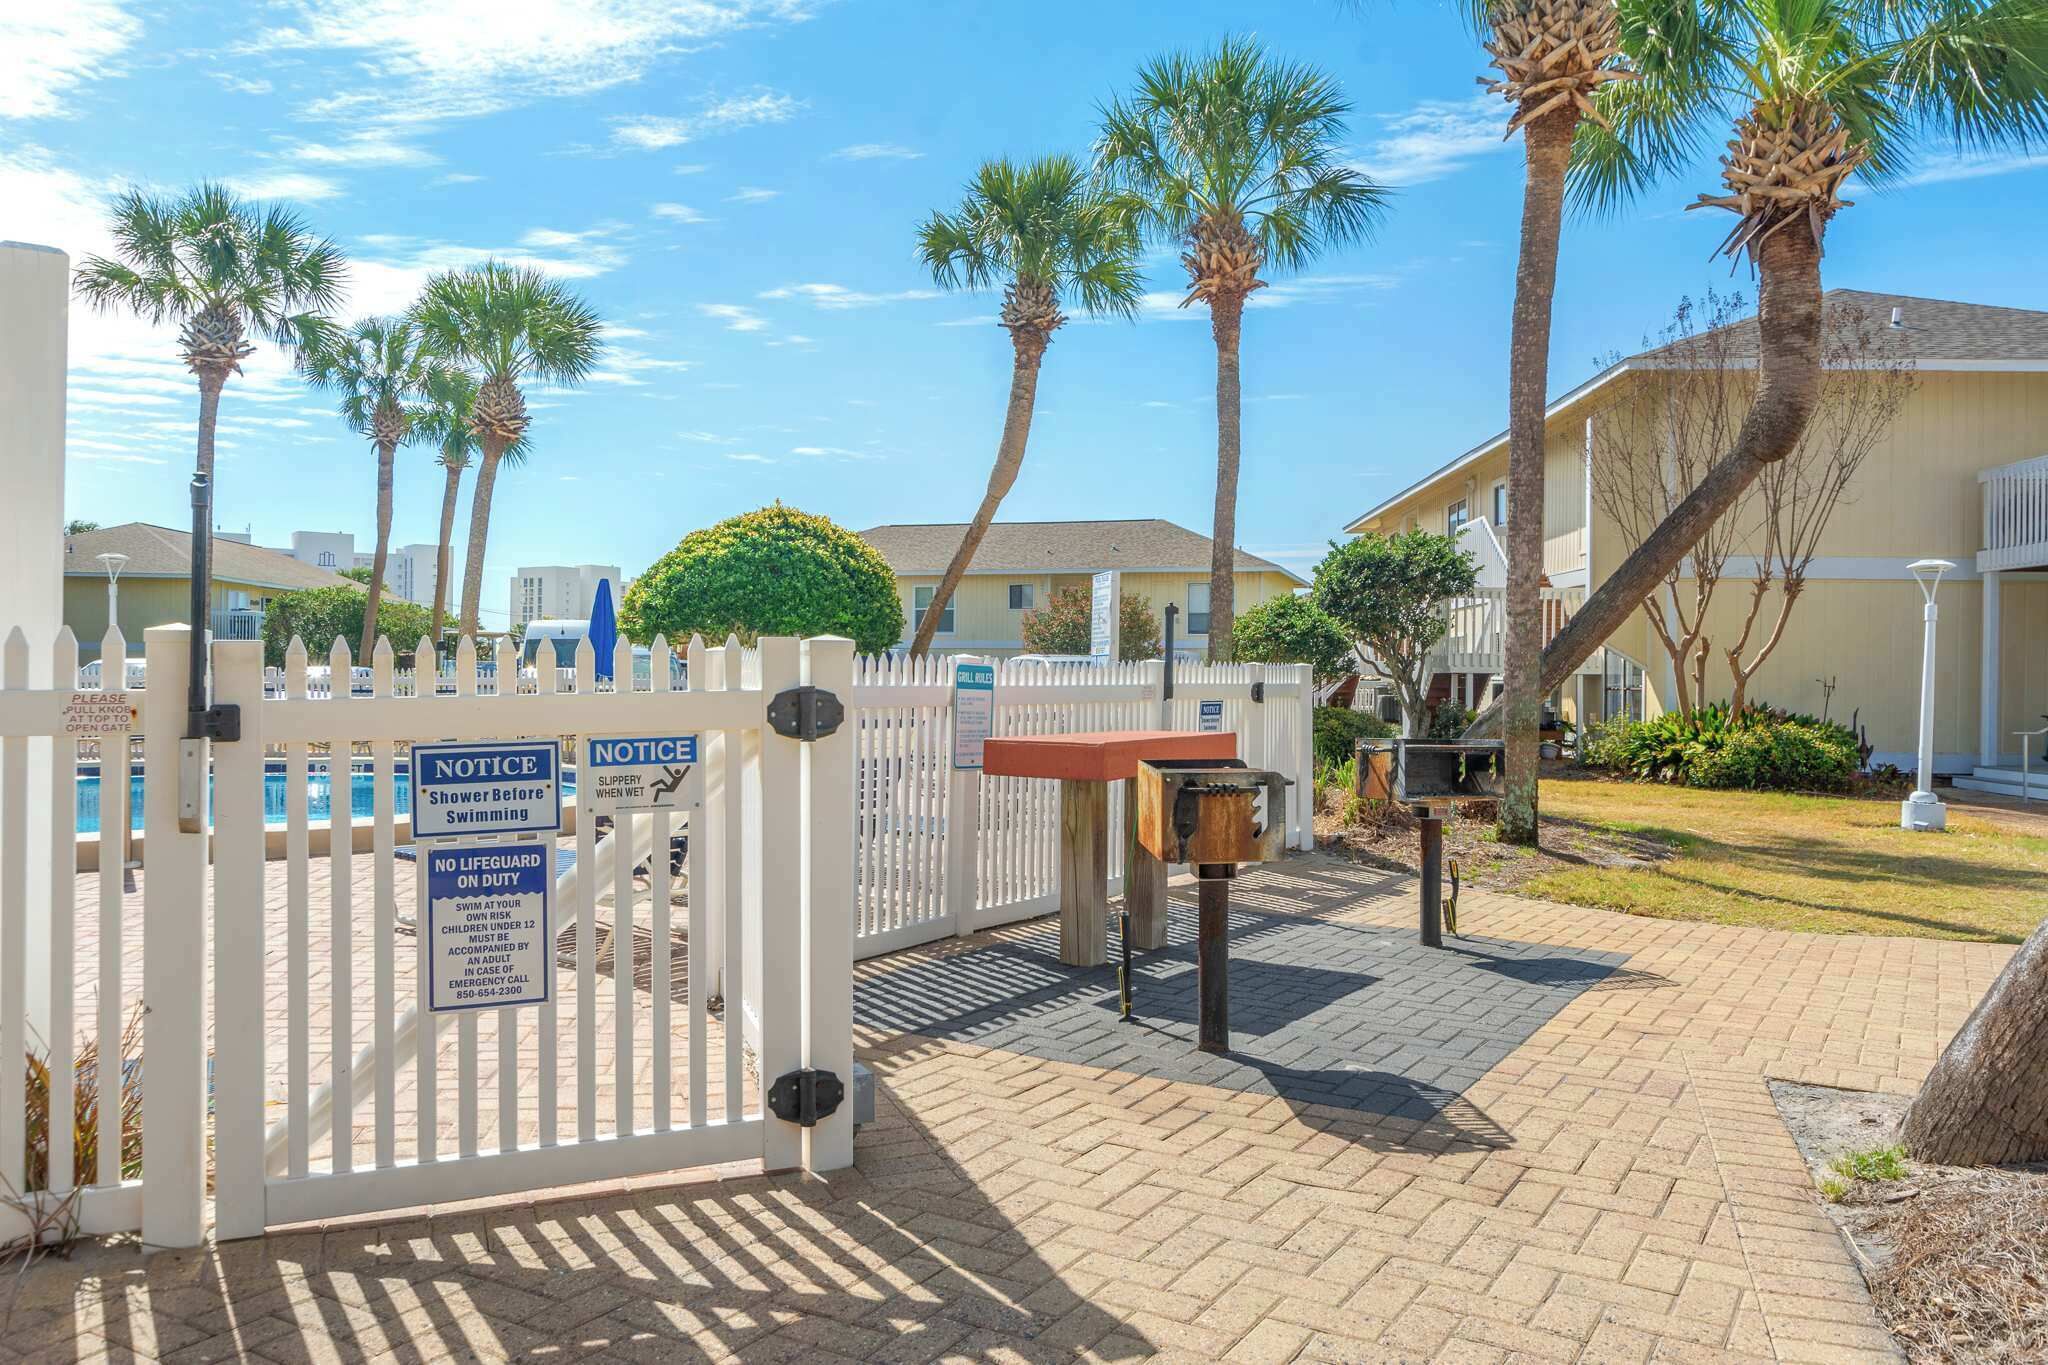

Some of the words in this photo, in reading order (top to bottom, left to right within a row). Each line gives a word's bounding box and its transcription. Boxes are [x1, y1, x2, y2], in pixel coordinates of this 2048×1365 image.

[957, 671, 974, 683] GRILL
[975, 672, 993, 684] RULES
[72, 693, 127, 703] PLEASE
[66, 705, 96, 714] PULL
[99, 705, 130, 714] KNOB
[1202, 705, 1220, 714] NOTICE
[70, 715, 84, 723] AT
[87, 715, 110, 723] TOP
[112, 715, 129, 723] TO
[66, 724, 98, 732] OPEN
[101, 723, 132, 732] GATE
[595, 740, 691, 763] NOTICE
[435, 756, 538, 778] NOTICE
[598, 774, 642, 786] SLIPPERY
[430, 790, 489, 805] Shower
[492, 787, 544, 801] Before
[596, 788, 623, 799] WHEN
[625, 786, 645, 797] WET
[446, 807, 529, 824] Swimming
[435, 858, 456, 873] NO
[460, 854, 541, 871] LIFEGUARD
[457, 875, 478, 888] ON
[482, 872, 521, 887] DUTY
[455, 902, 482, 912] SWIM
[484, 901, 495, 910] AT
[496, 899, 521, 909] YOUR
[466, 912, 488, 922] OWN
[490, 911, 512, 920] RISK
[441, 923, 488, 935] CHILDREN
[490, 921, 522, 931] UNDER
[524, 920, 535, 929] 12
[469, 934, 496, 943] MUST
[497, 932, 510, 942] BE
[448, 943, 516, 956] ACCOMPANIED
[518, 942, 530, 951] BY
[467, 957, 480, 965] AN
[482, 954, 511, 964] ADULT
[464, 968, 474, 976] IN
[476, 966, 501, 976] CASE
[502, 964, 515, 974] OF
[449, 976, 506, 989] EMERGENCY
[507, 974, 530, 984] CALL
[456, 985, 522, 999] 850-654-2300
